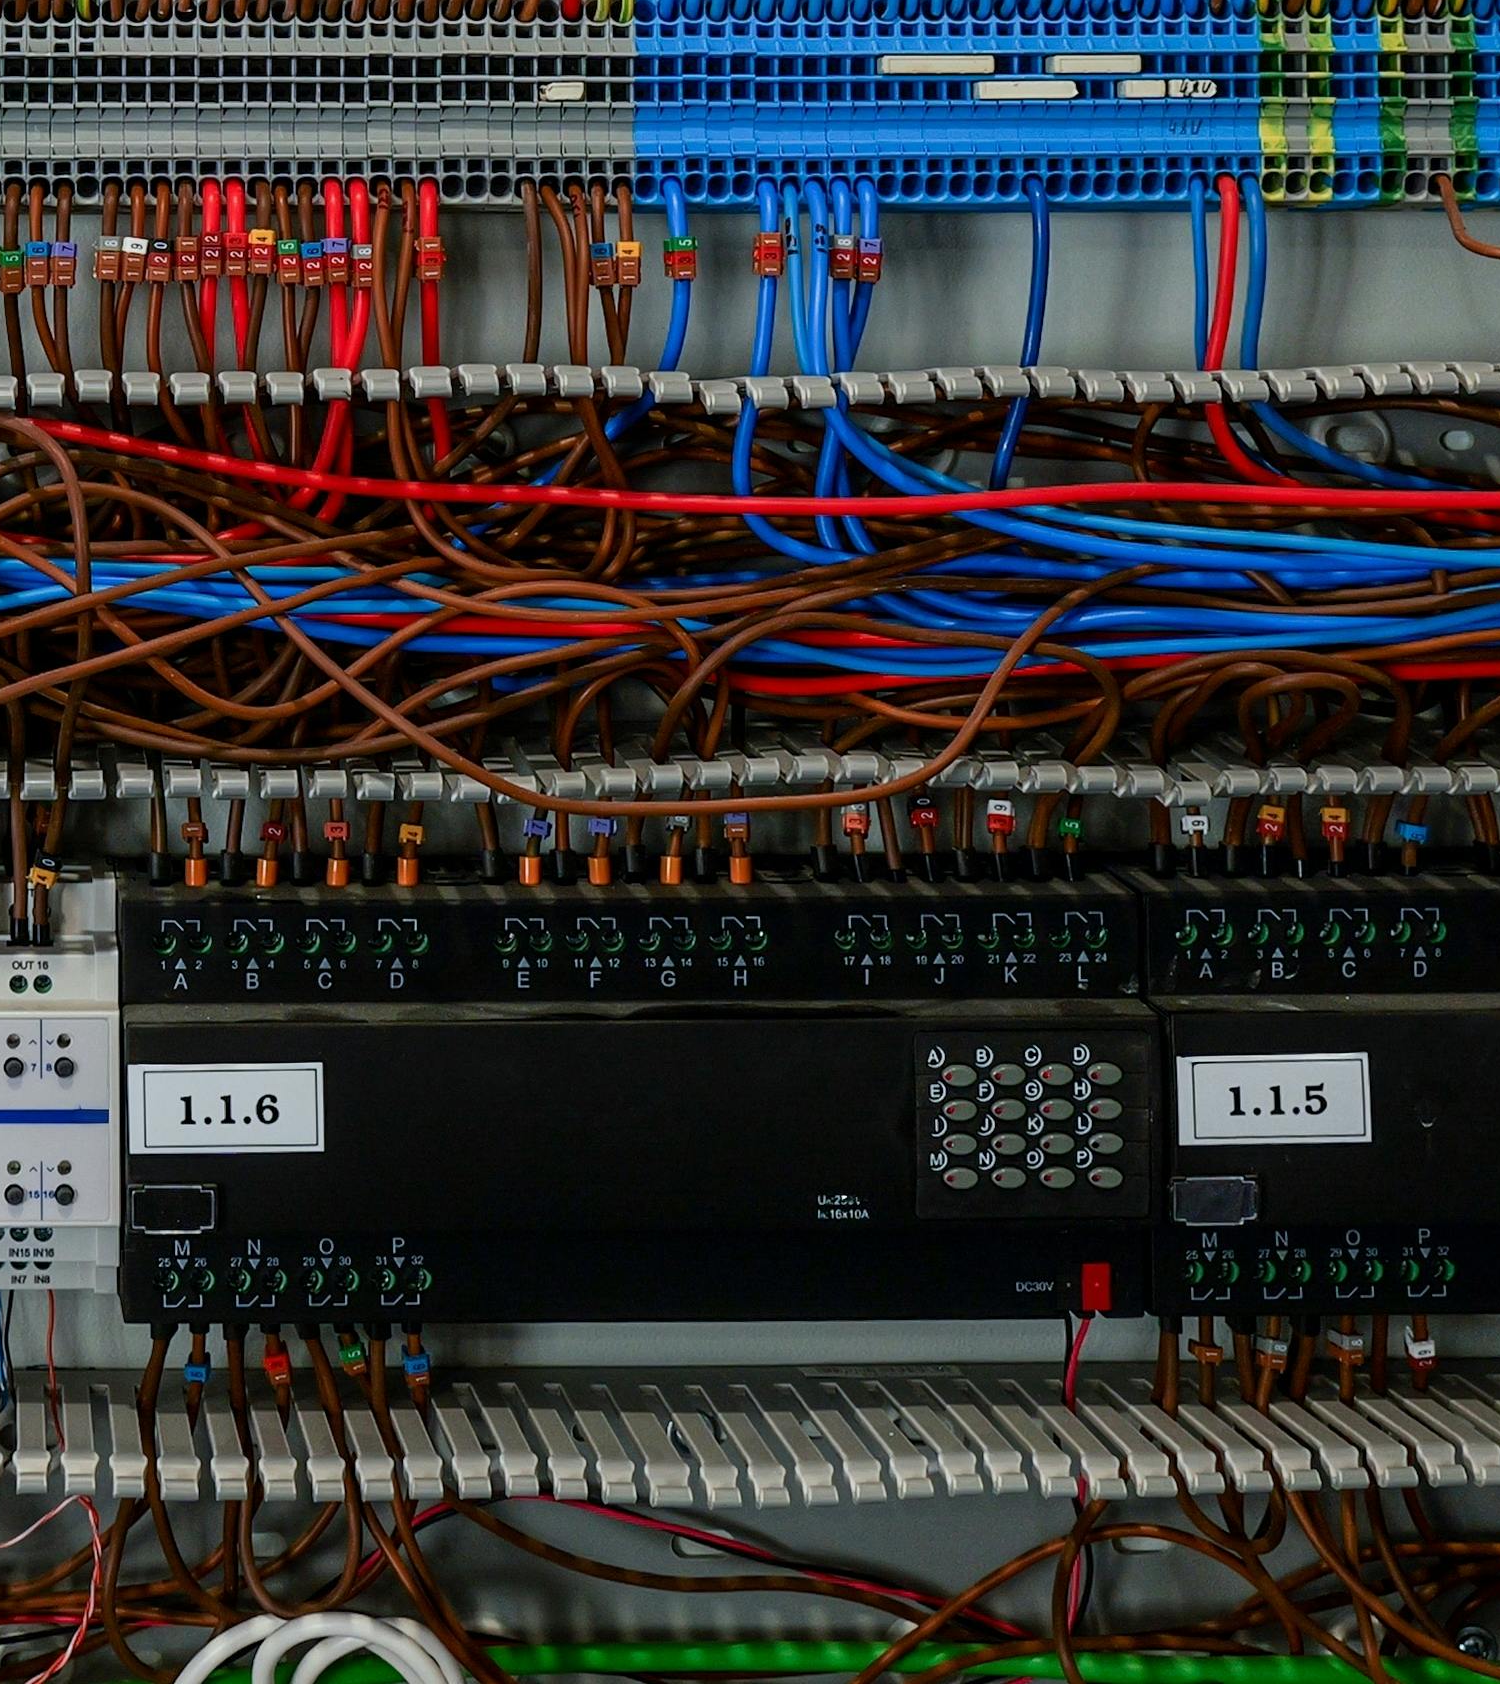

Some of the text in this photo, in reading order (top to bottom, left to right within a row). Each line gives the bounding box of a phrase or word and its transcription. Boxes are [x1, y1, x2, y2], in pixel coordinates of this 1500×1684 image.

[12, 961, 48, 970] OUT 16
[174, 973, 187, 989] A
[247, 973, 259, 989] B
[318, 972, 332, 989] C
[391, 972, 404, 988] D
[518, 972, 530, 988] E
[590, 971, 601, 988] F
[661, 970, 675, 987] G
[734, 970, 747, 986] H
[1078, 967, 1088, 983] L
[1229, 1083, 1327, 1116] 1.1.5
[180, 1094, 279, 1125] 1.1.6
[9, 1249, 30, 1258] IN15
[33, 1249, 54, 1258] IN16
[175, 1238, 190, 1255] M
[248, 1238, 261, 1255] N
[319, 1238, 334, 1255] O
[392, 1238, 405, 1255] P
[1016, 1282, 1054, 1292] DC30V
